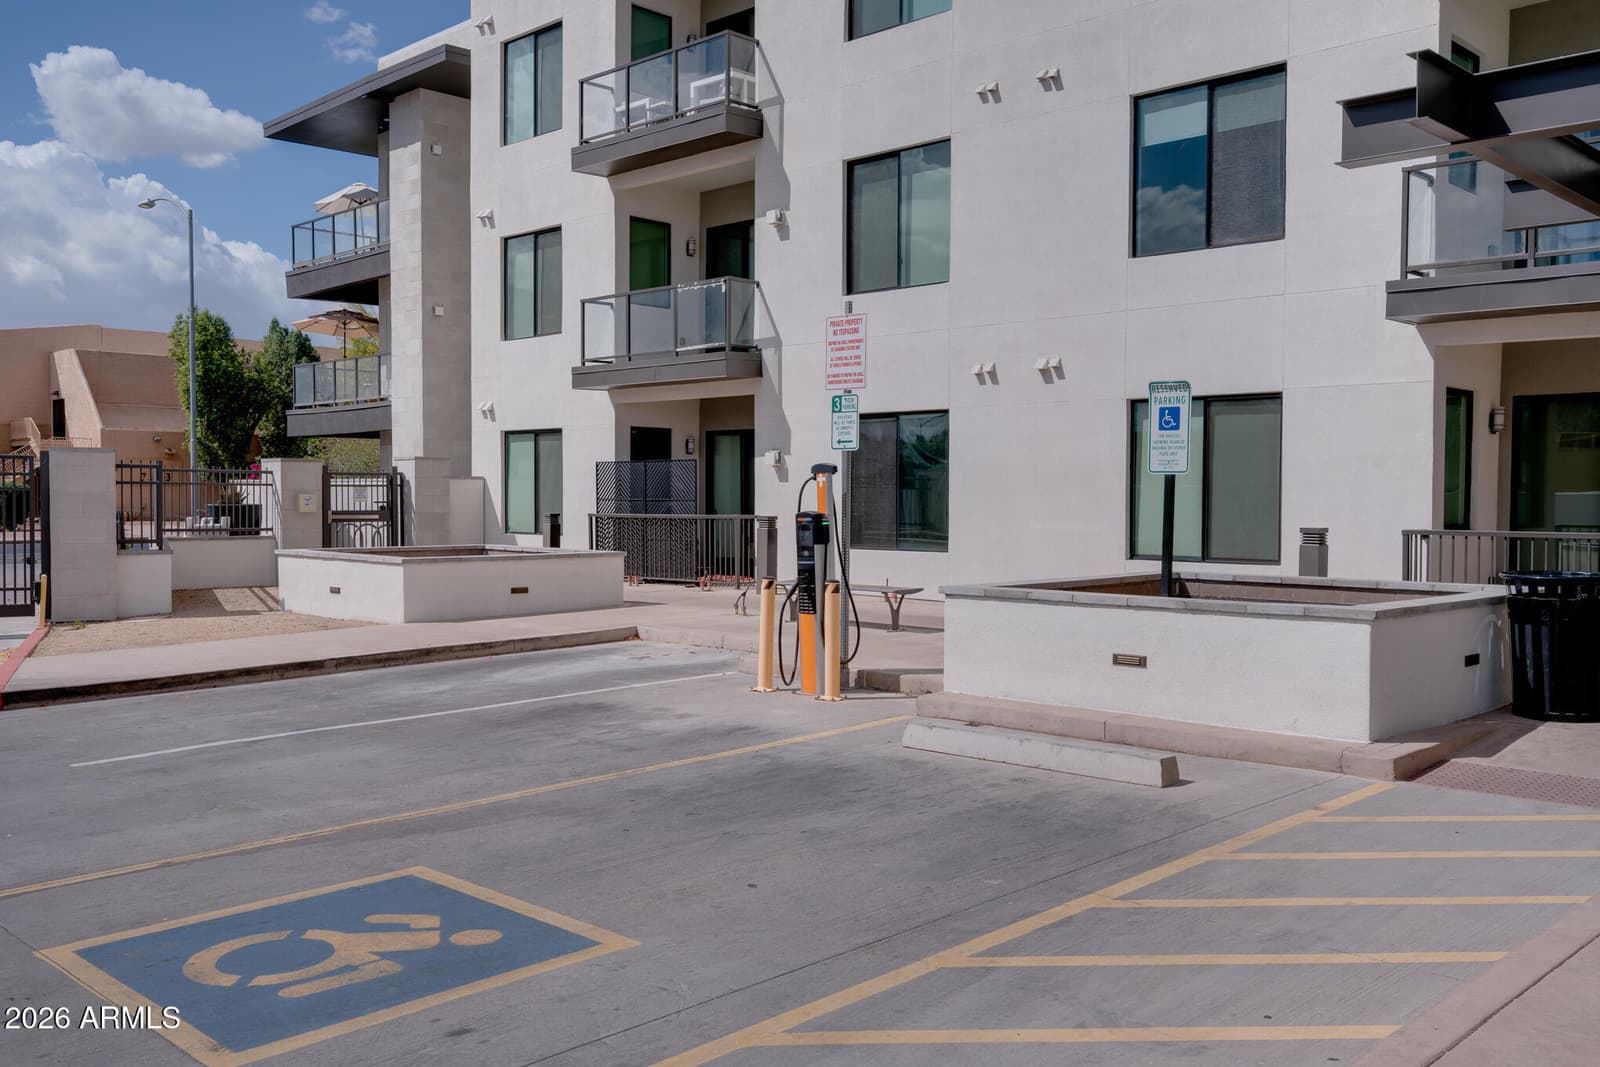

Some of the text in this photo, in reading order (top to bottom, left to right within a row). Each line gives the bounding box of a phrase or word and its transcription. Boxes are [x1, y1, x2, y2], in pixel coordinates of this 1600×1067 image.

[845, 318, 863, 326] PROPERTY
[1151, 384, 1189, 393] RESERVED
[834, 398, 841, 411] 3
[1153, 396, 1186, 405] PARKING
